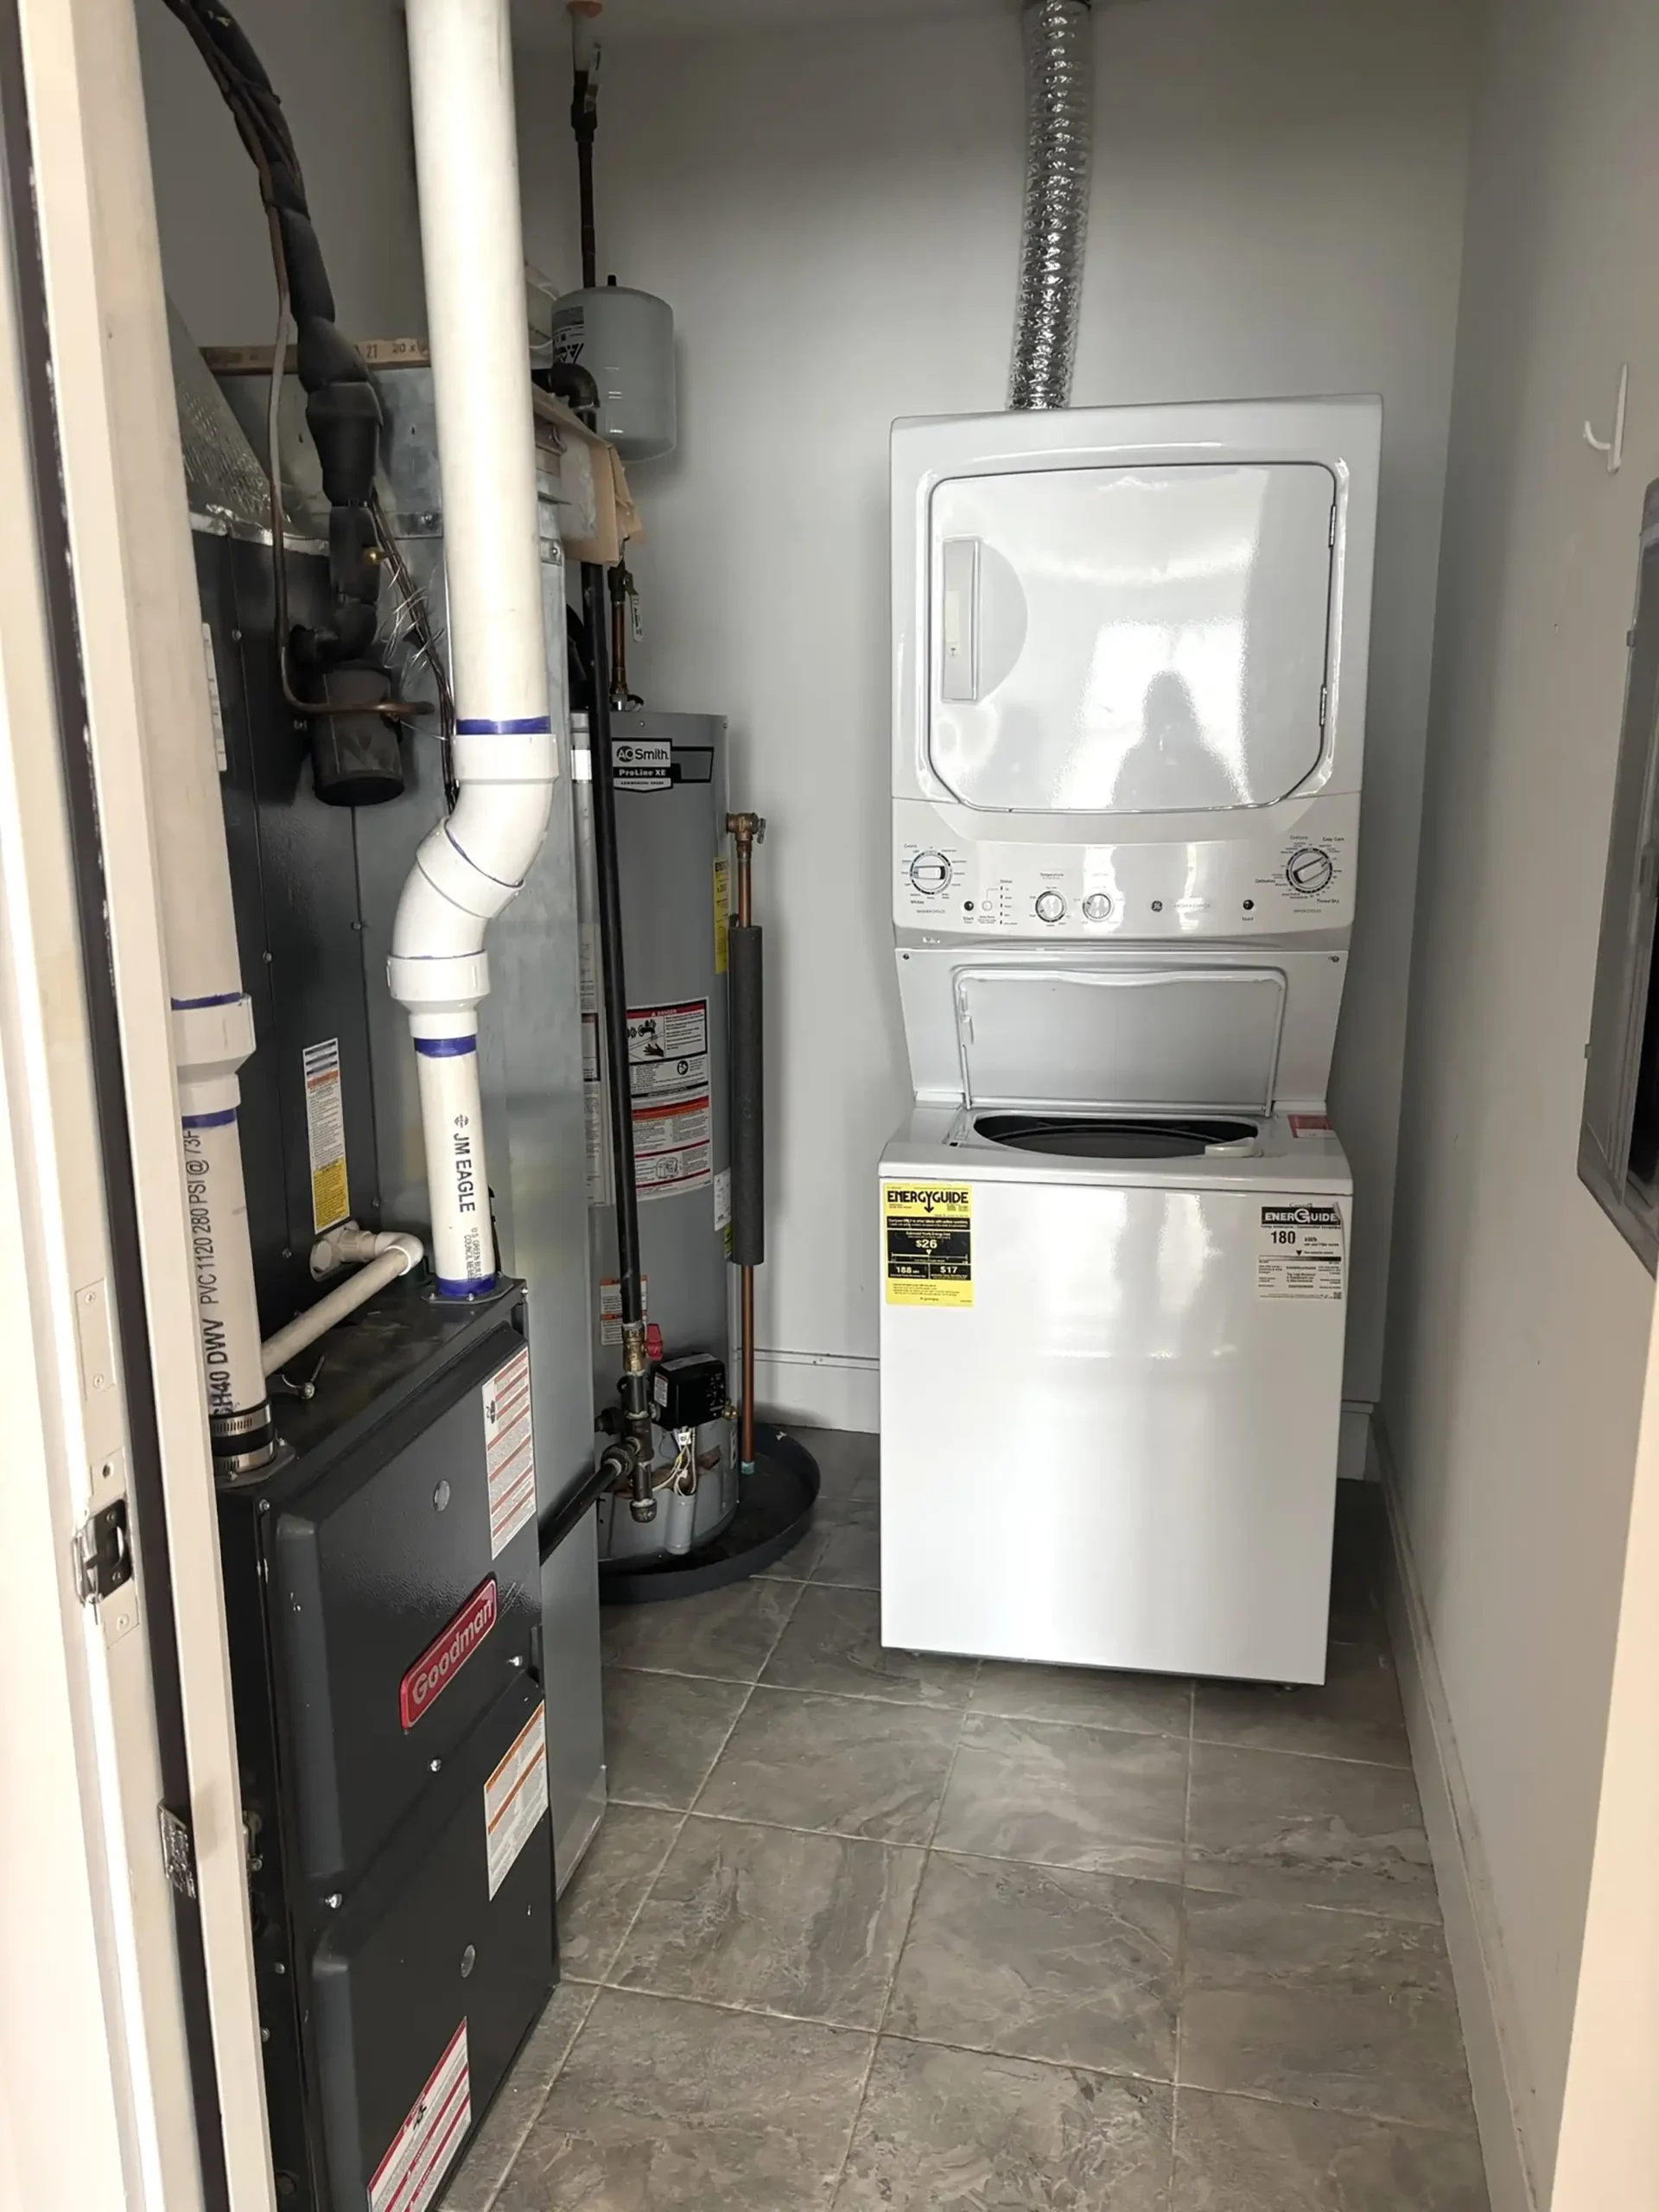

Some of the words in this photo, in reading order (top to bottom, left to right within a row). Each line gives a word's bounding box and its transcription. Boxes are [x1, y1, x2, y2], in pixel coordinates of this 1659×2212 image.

[453, 1133, 471, 1154] JM
[185, 1160, 209, 1175] @
[187, 1180, 207, 1204] PSI
[455, 1159, 475, 1212] EAGLE
[190, 1208, 211, 1233] 280
[916, 1239, 938, 1249] $26
[1271, 1230, 1296, 1244] 180
[193, 1237, 215, 1269] 1120
[940, 1266, 958, 1274] $17
[198, 1274, 219, 1304] PVC
[202, 1319, 228, 1364] DWV
[412, 1599, 493, 1704] Goodman
